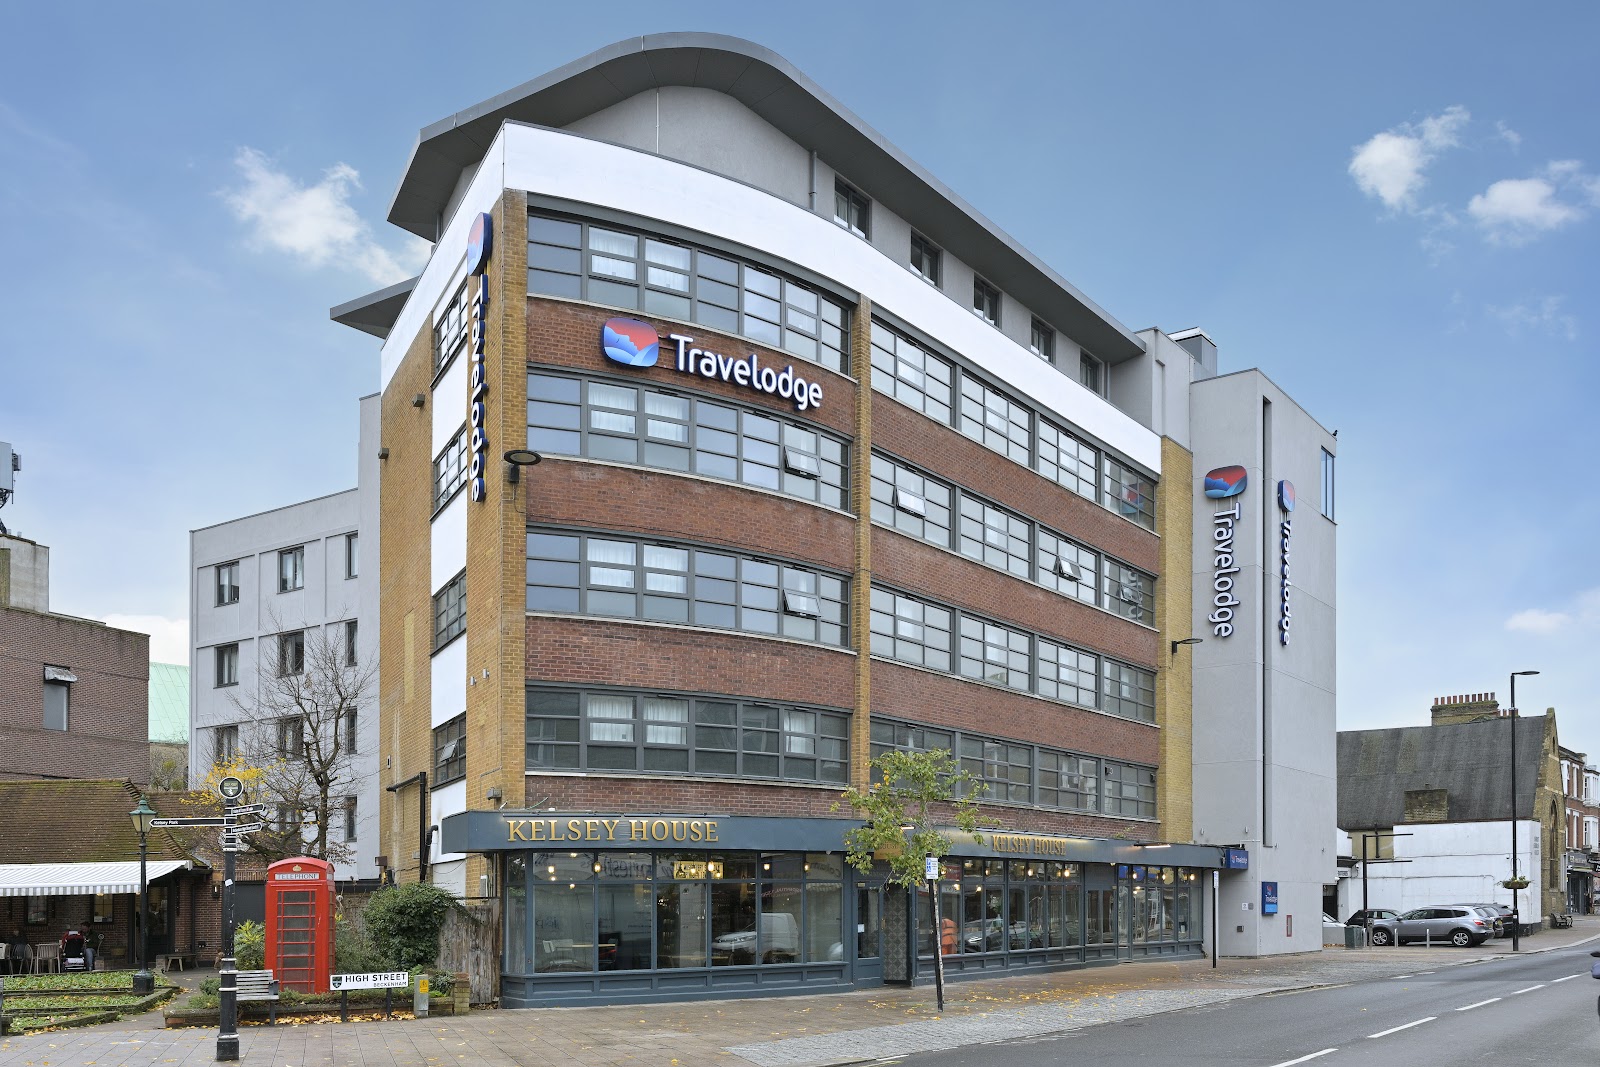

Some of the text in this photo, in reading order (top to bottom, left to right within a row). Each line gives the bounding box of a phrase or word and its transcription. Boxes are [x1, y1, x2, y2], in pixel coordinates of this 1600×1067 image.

[469, 274, 488, 502] Travelodge
[669, 333, 823, 411] Travelodge
[1208, 502, 1241, 637] Travelodge
[1281, 520, 1292, 646] Travelodge
[506, 819, 719, 842] KELSEY HOUSE
[992, 834, 1067, 856] KELSEY HOUSE
[345, 973, 407, 983] HIGH STREET
